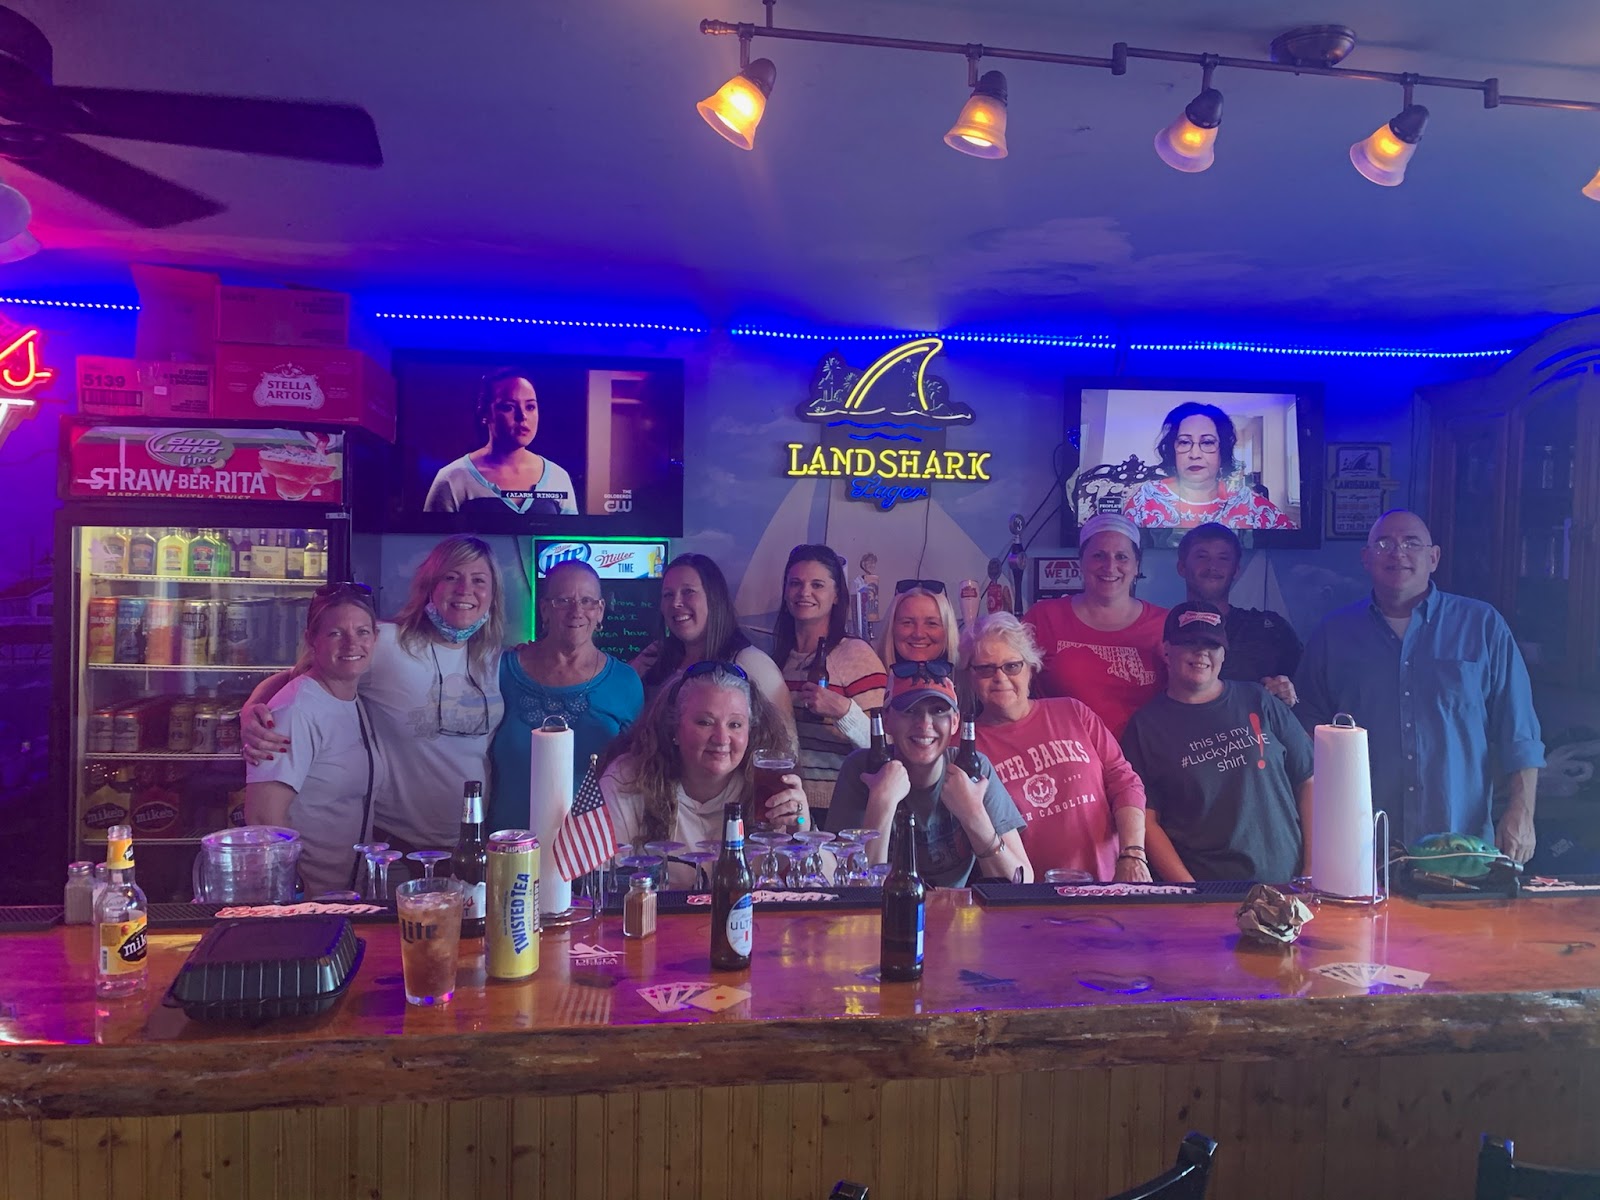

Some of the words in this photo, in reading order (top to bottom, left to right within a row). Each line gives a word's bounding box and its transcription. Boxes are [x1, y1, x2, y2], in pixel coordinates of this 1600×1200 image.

[83, 373, 126, 388] 5139
[267, 380, 312, 391] STELLA
[266, 390, 312, 401] ARTOIS
[154, 445, 224, 454] LIGHT
[166, 436, 222, 446] BUD
[787, 443, 992, 481] LANDSHARK
[850, 476, 928, 509] Lager
[604, 500, 633, 513] CW
[594, 551, 636, 568] Miller
[618, 563, 635, 573] TIME
[1044, 568, 1065, 579] WE
[1188, 736, 1214, 752] this
[1214, 732, 1228, 744] is
[1229, 726, 1250, 738] my
[995, 754, 1031, 785] TER
[1027, 739, 1091, 774] BANKS
[1216, 753, 1248, 773] shirt
[1038, 793, 1097, 818] CAROLINA
[510, 873, 531, 898] TEA
[510, 898, 531, 955] TWISTED
